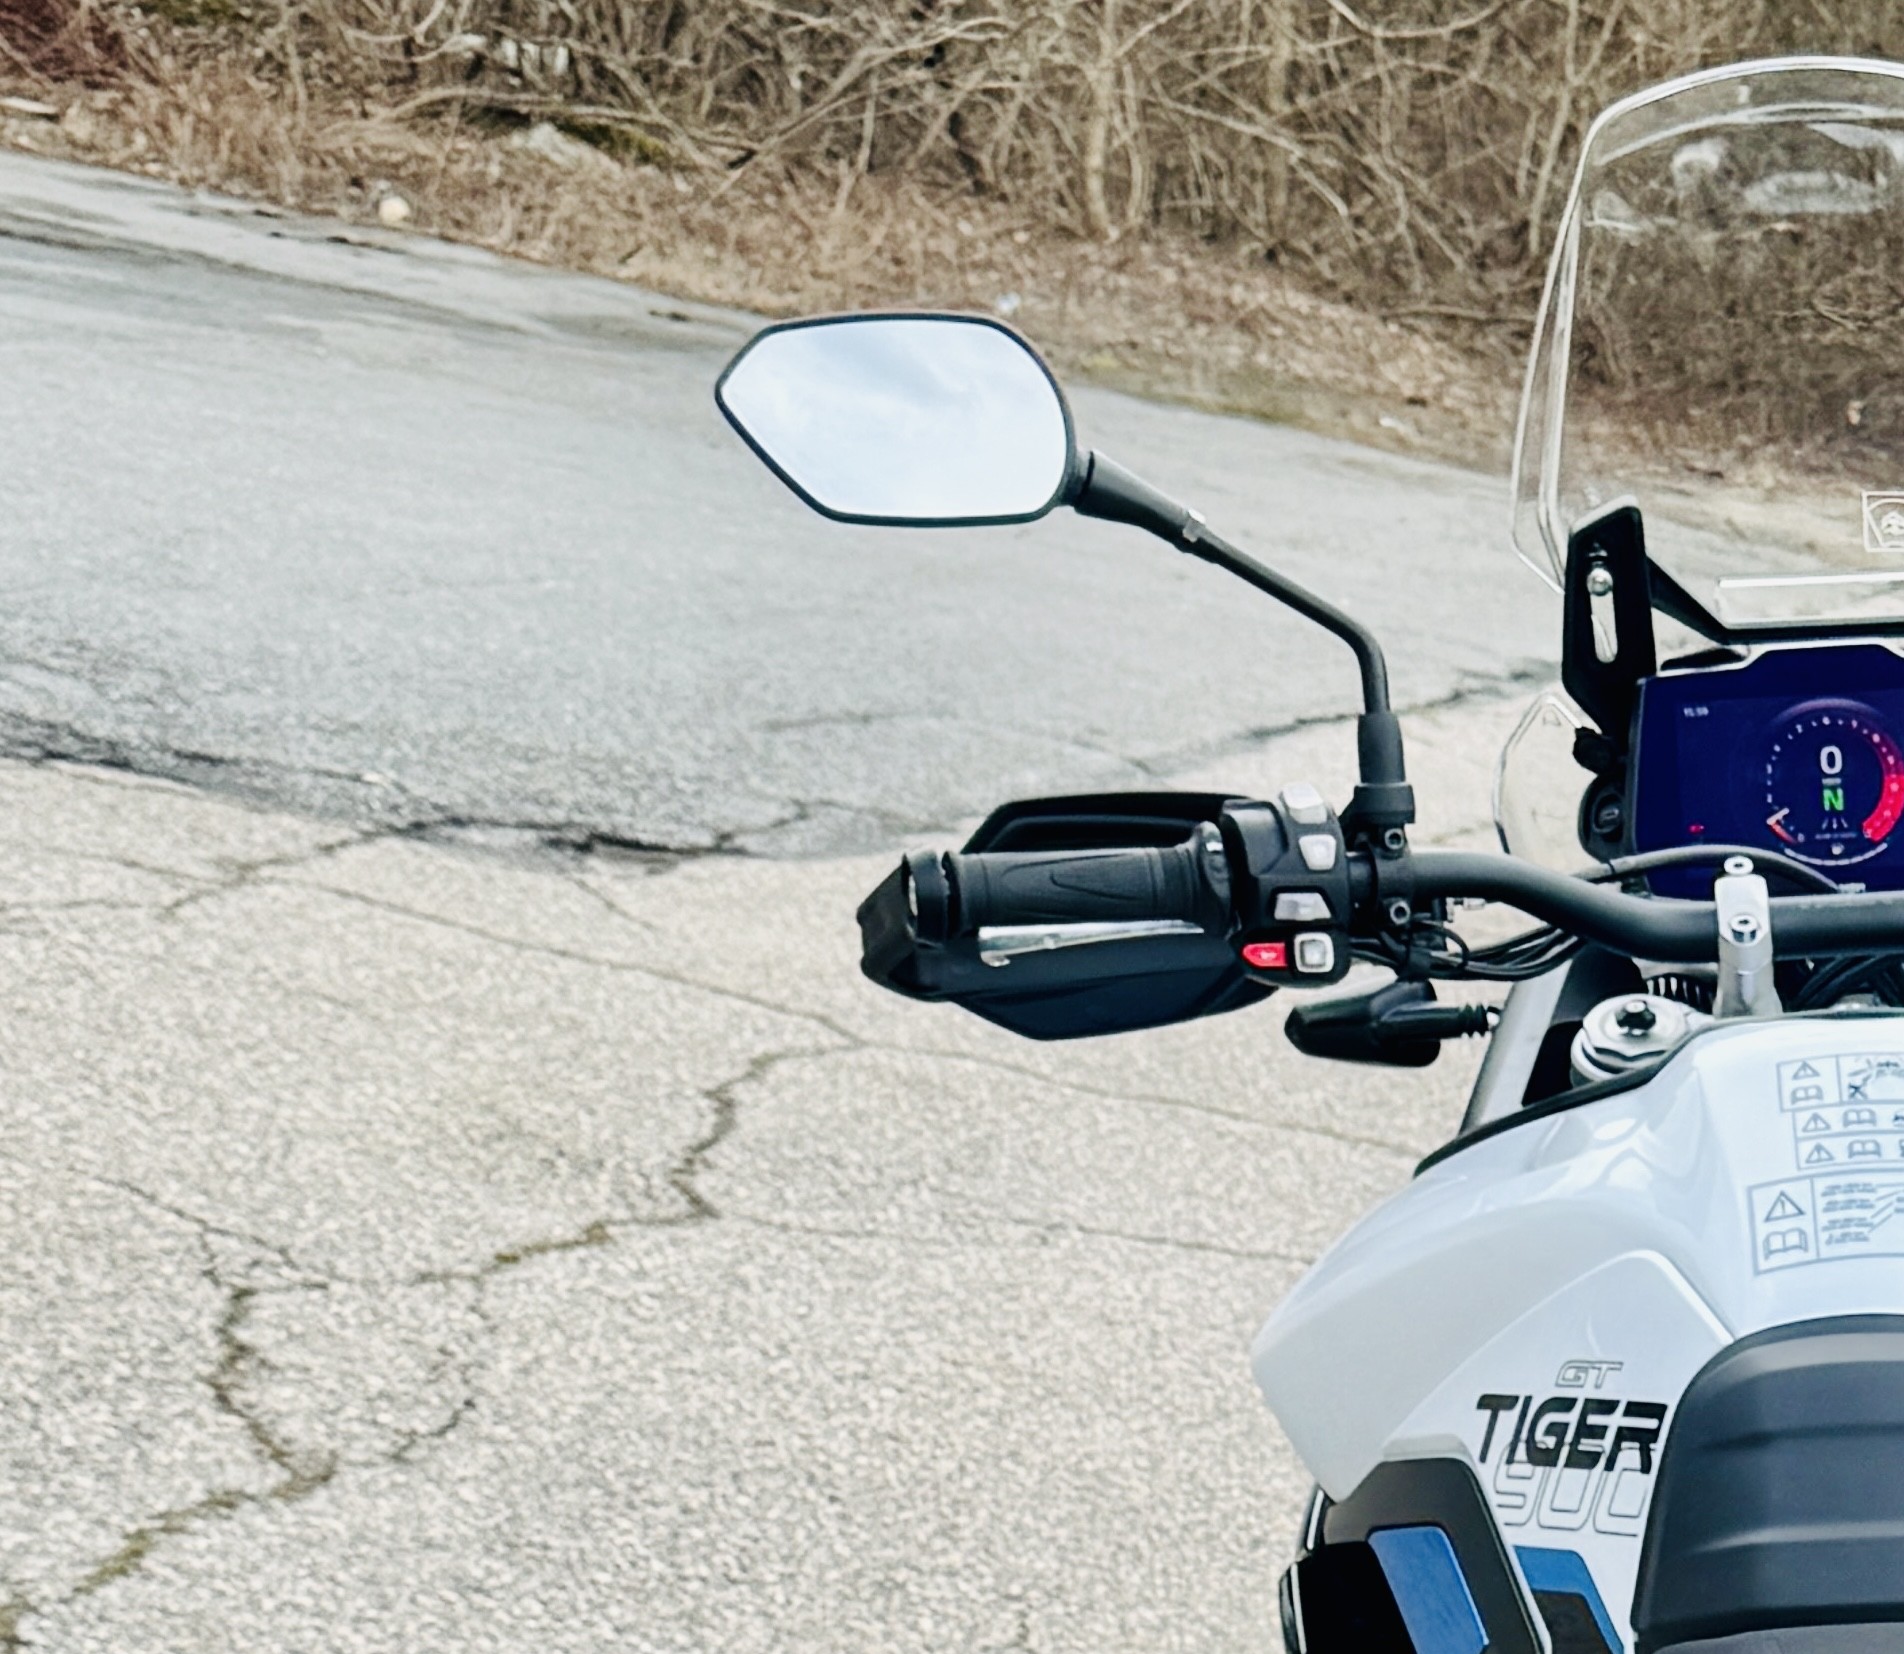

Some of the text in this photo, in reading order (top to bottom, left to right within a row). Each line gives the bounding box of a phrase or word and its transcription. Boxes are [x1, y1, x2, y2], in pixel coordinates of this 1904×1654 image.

[1820, 745, 1843, 775] 0
[1822, 787, 1844, 811] N
[1555, 1360, 1624, 1389] GT
[1476, 1393, 1668, 1475] TIGER
